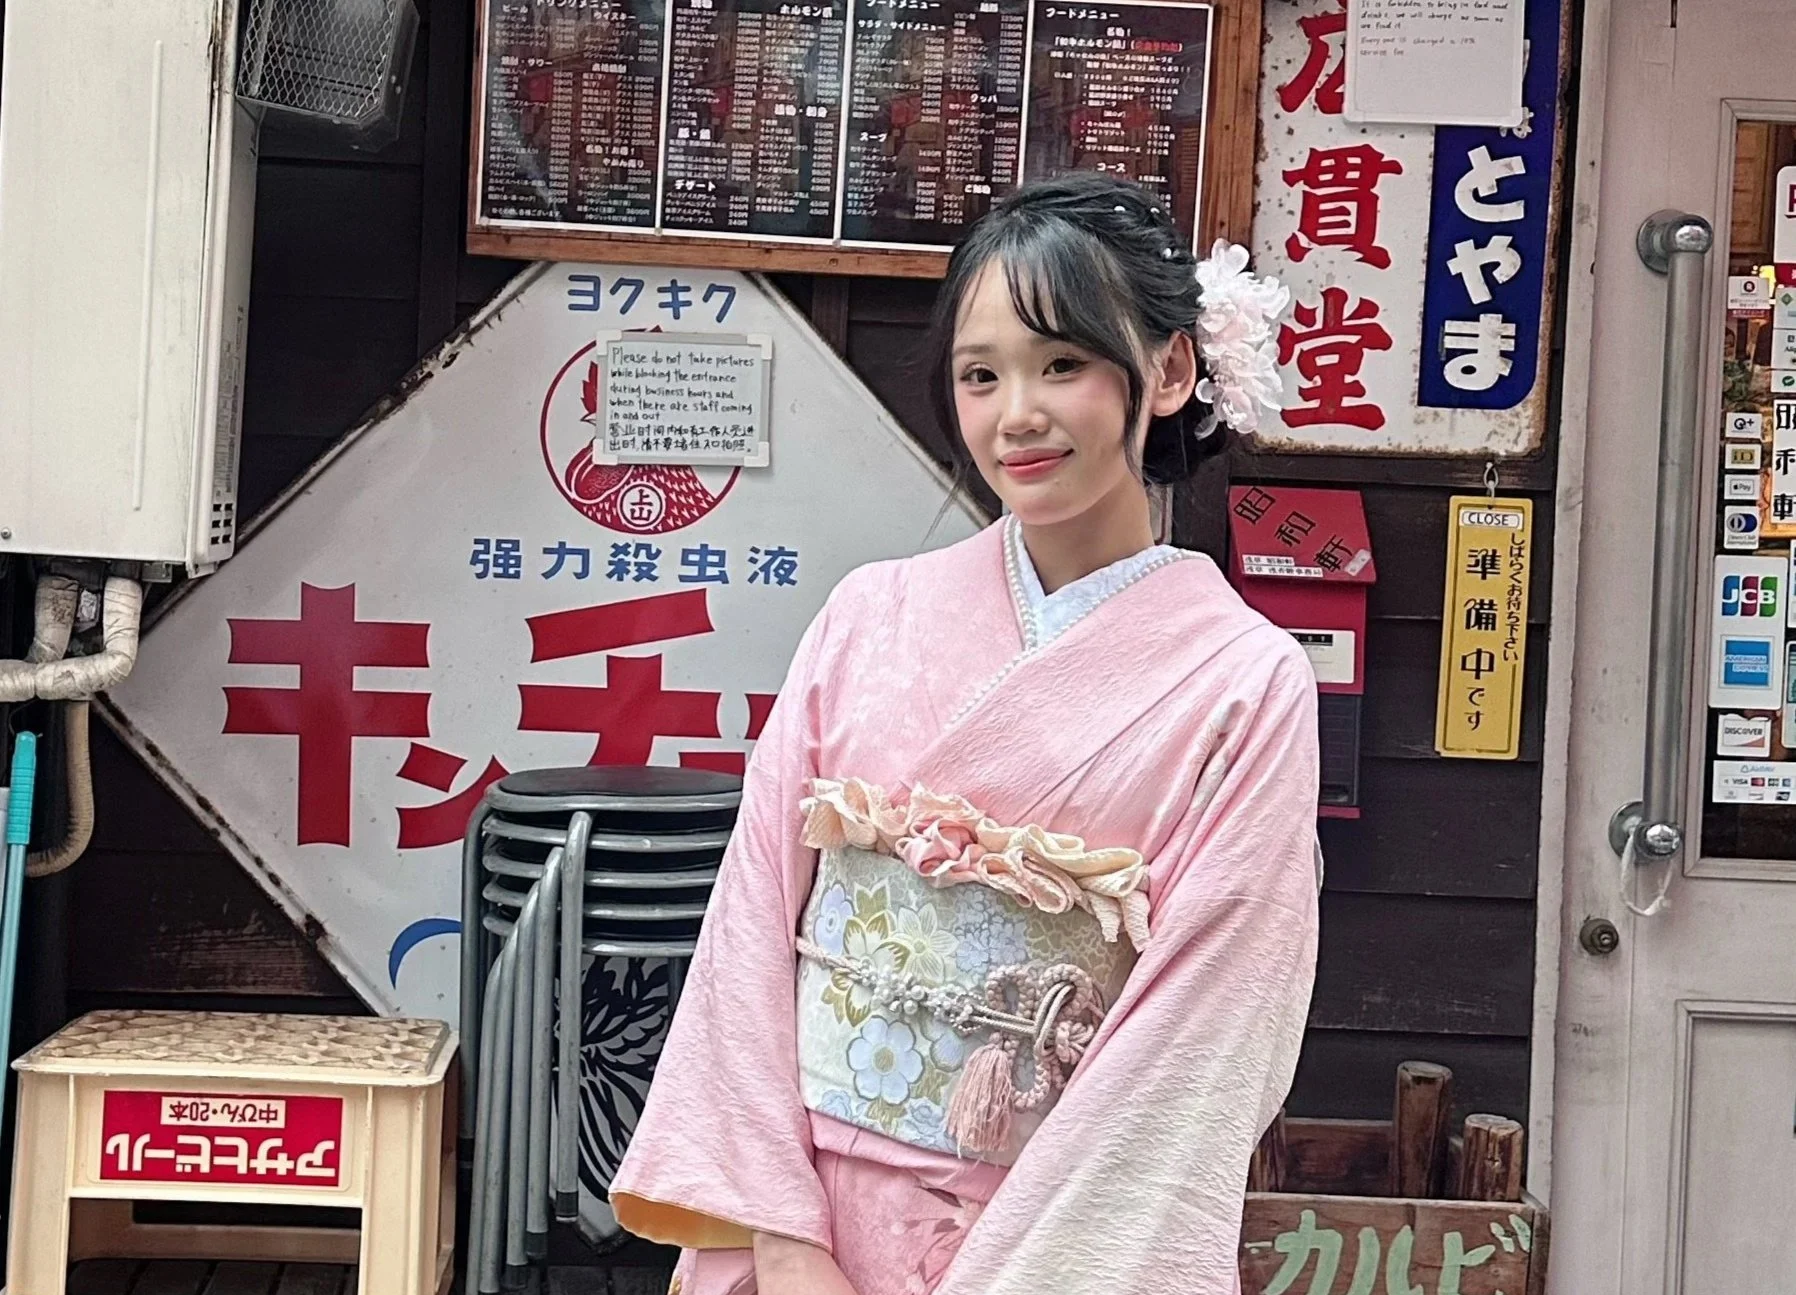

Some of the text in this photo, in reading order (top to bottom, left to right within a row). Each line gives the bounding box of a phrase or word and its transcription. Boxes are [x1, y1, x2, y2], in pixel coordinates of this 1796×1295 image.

[502, 5, 529, 13] ビール
[593, 11, 636, 21] ウイスキー
[1045, 8, 1120, 19] フードメニュー
[858, 19, 946, 31] サラダ・サイドメニュー
[970, 93, 998, 103] クッパ
[859, 131, 888, 142] スープ
[1097, 162, 1127, 173] コース
[675, 179, 716, 192] デザート
[1443, 145, 1526, 391] とやま
[567, 274, 737, 322] ヨクキク
[612, 346, 755, 368] Please do not take pictures
[610, 368, 737, 382] while blocking the entrance
[610, 385, 734, 399] during business hours and
[609, 398, 752, 415] when there are staff coming
[609, 411, 660, 421] in and out
[1467, 512, 1510, 527] CLOSE
[1233, 486, 1353, 573] 昭和軒
[1503, 532, 1527, 662] しばらくお待ち下さい
[1460, 547, 1502, 732] 準備中です
[1724, 727, 1763, 736] DISCOVER
[104, 1132, 336, 1178] アサヒビール
